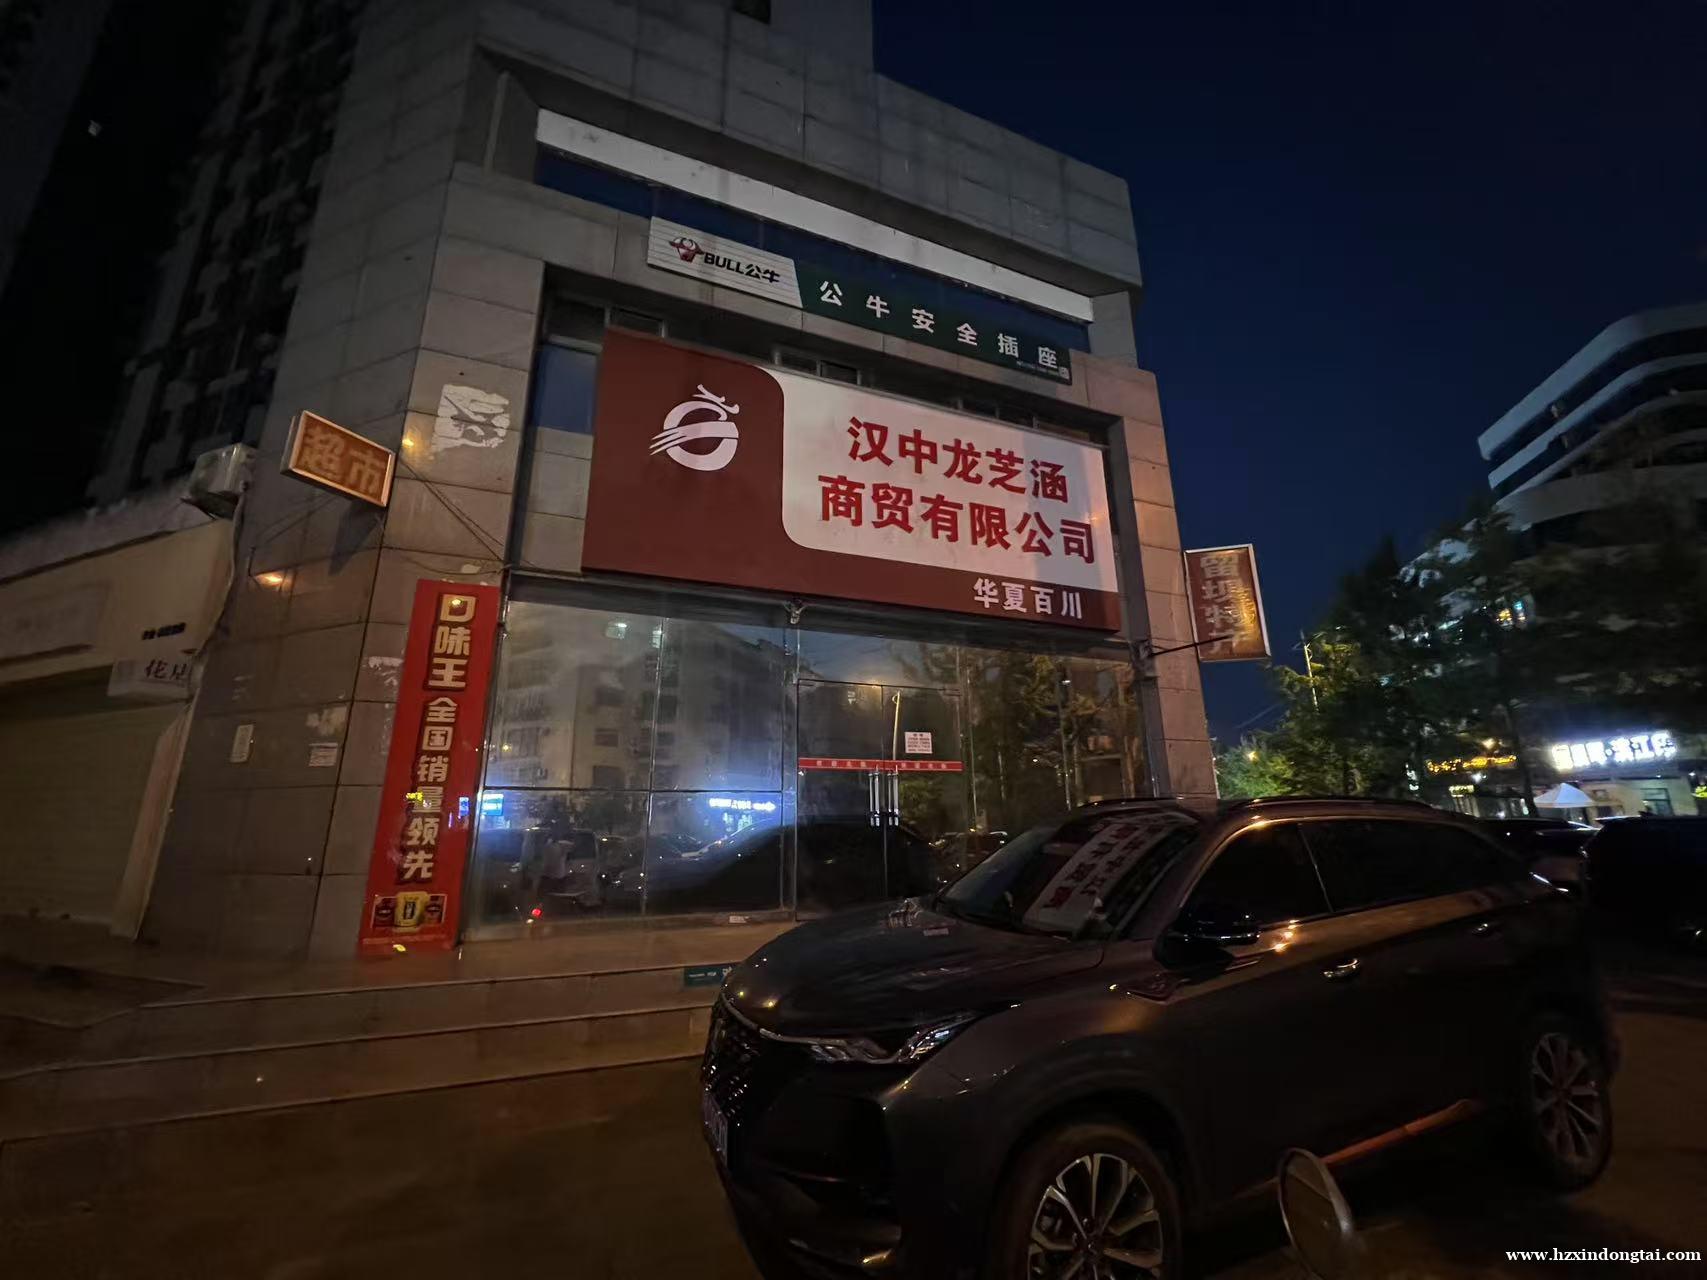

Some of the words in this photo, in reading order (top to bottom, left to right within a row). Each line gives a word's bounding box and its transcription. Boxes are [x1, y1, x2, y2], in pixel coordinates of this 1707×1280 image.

[819, 280, 1058, 369] 公牛安全插座
[297, 425, 385, 495] 超市
[847, 416, 1069, 503] 汉中龙芝涵
[818, 475, 1095, 564] 商贸有限公司
[973, 577, 1083, 620] 华夏百川
